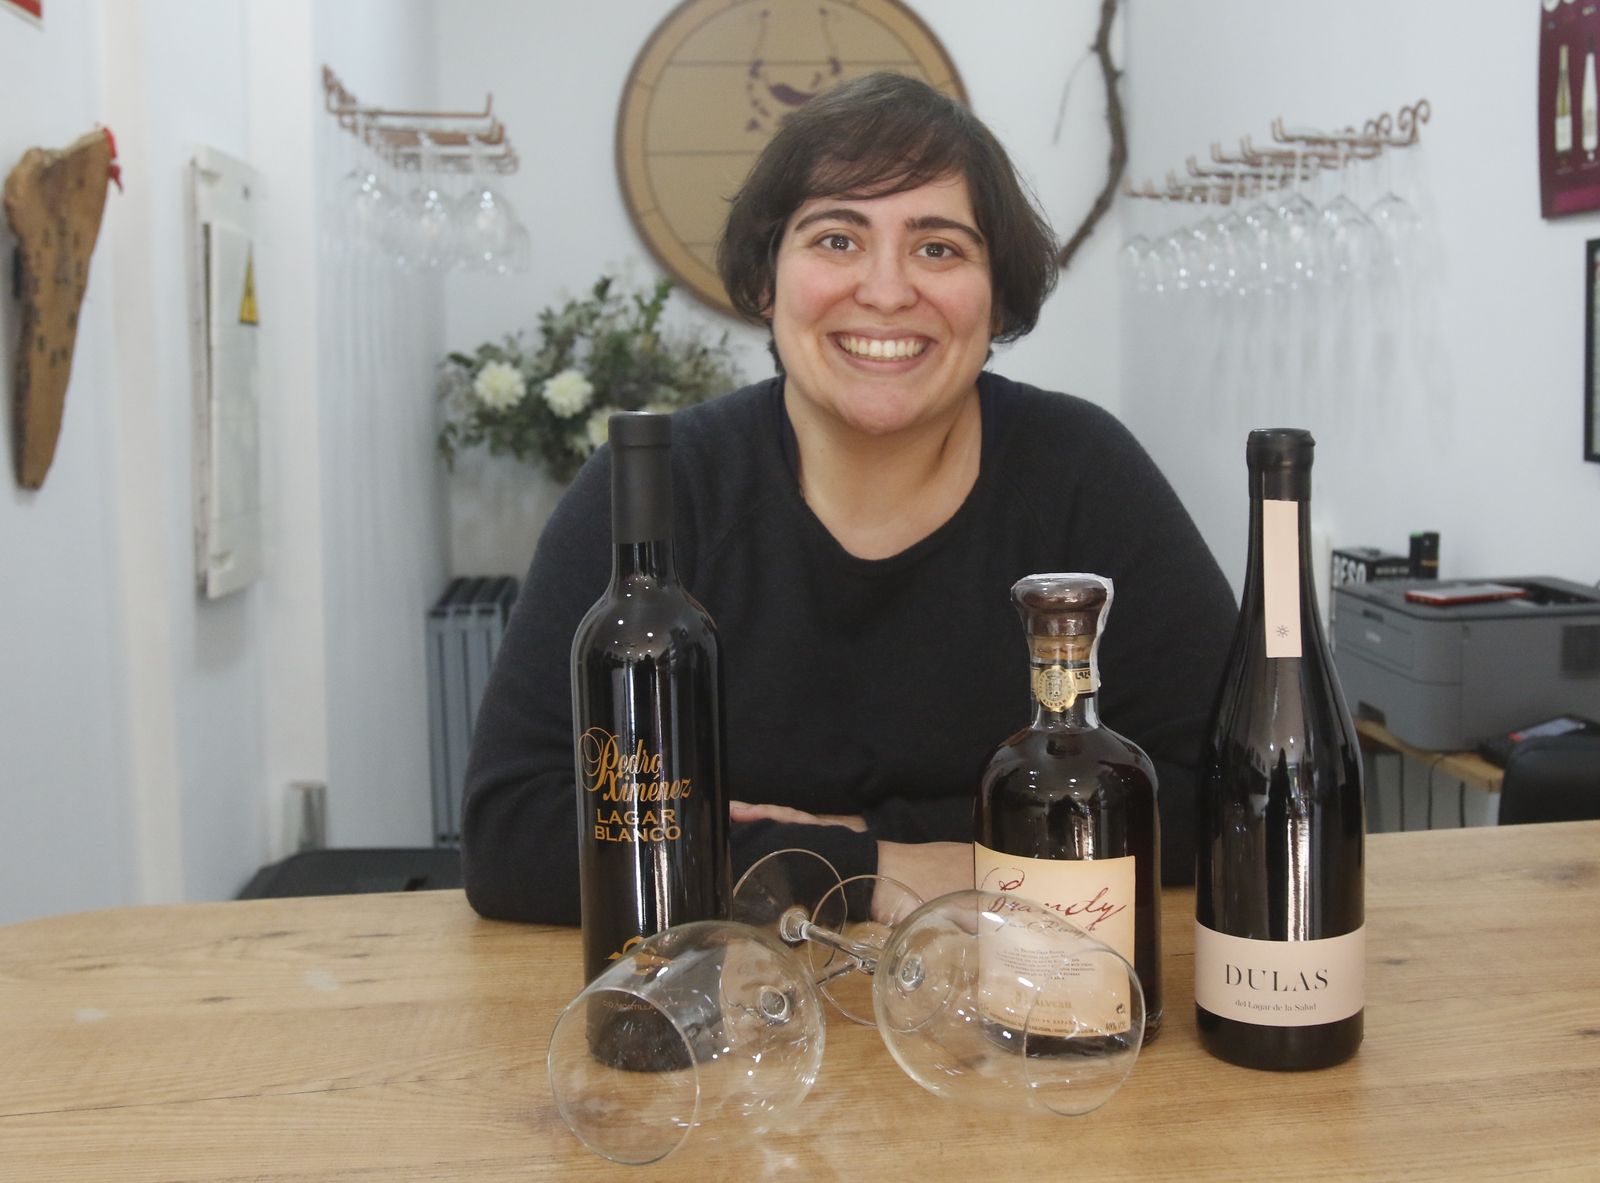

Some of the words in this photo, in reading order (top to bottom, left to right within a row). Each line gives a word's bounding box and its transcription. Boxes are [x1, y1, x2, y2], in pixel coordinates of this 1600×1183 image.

[578, 727, 662, 791] Pedro
[603, 770, 692, 801] Ximénez
[596, 808, 677, 825] LAGAR
[594, 825, 681, 842] BLANCO
[981, 867, 1126, 931] Brandy
[1226, 964, 1328, 991] DULAS
[1235, 1000, 1247, 1008] del
[1249, 1002, 1270, 1012] Lagar
[1272, 1004, 1282, 1012] de
[1285, 1004, 1292, 1012] la
[1295, 1003, 1317, 1012] Salud
